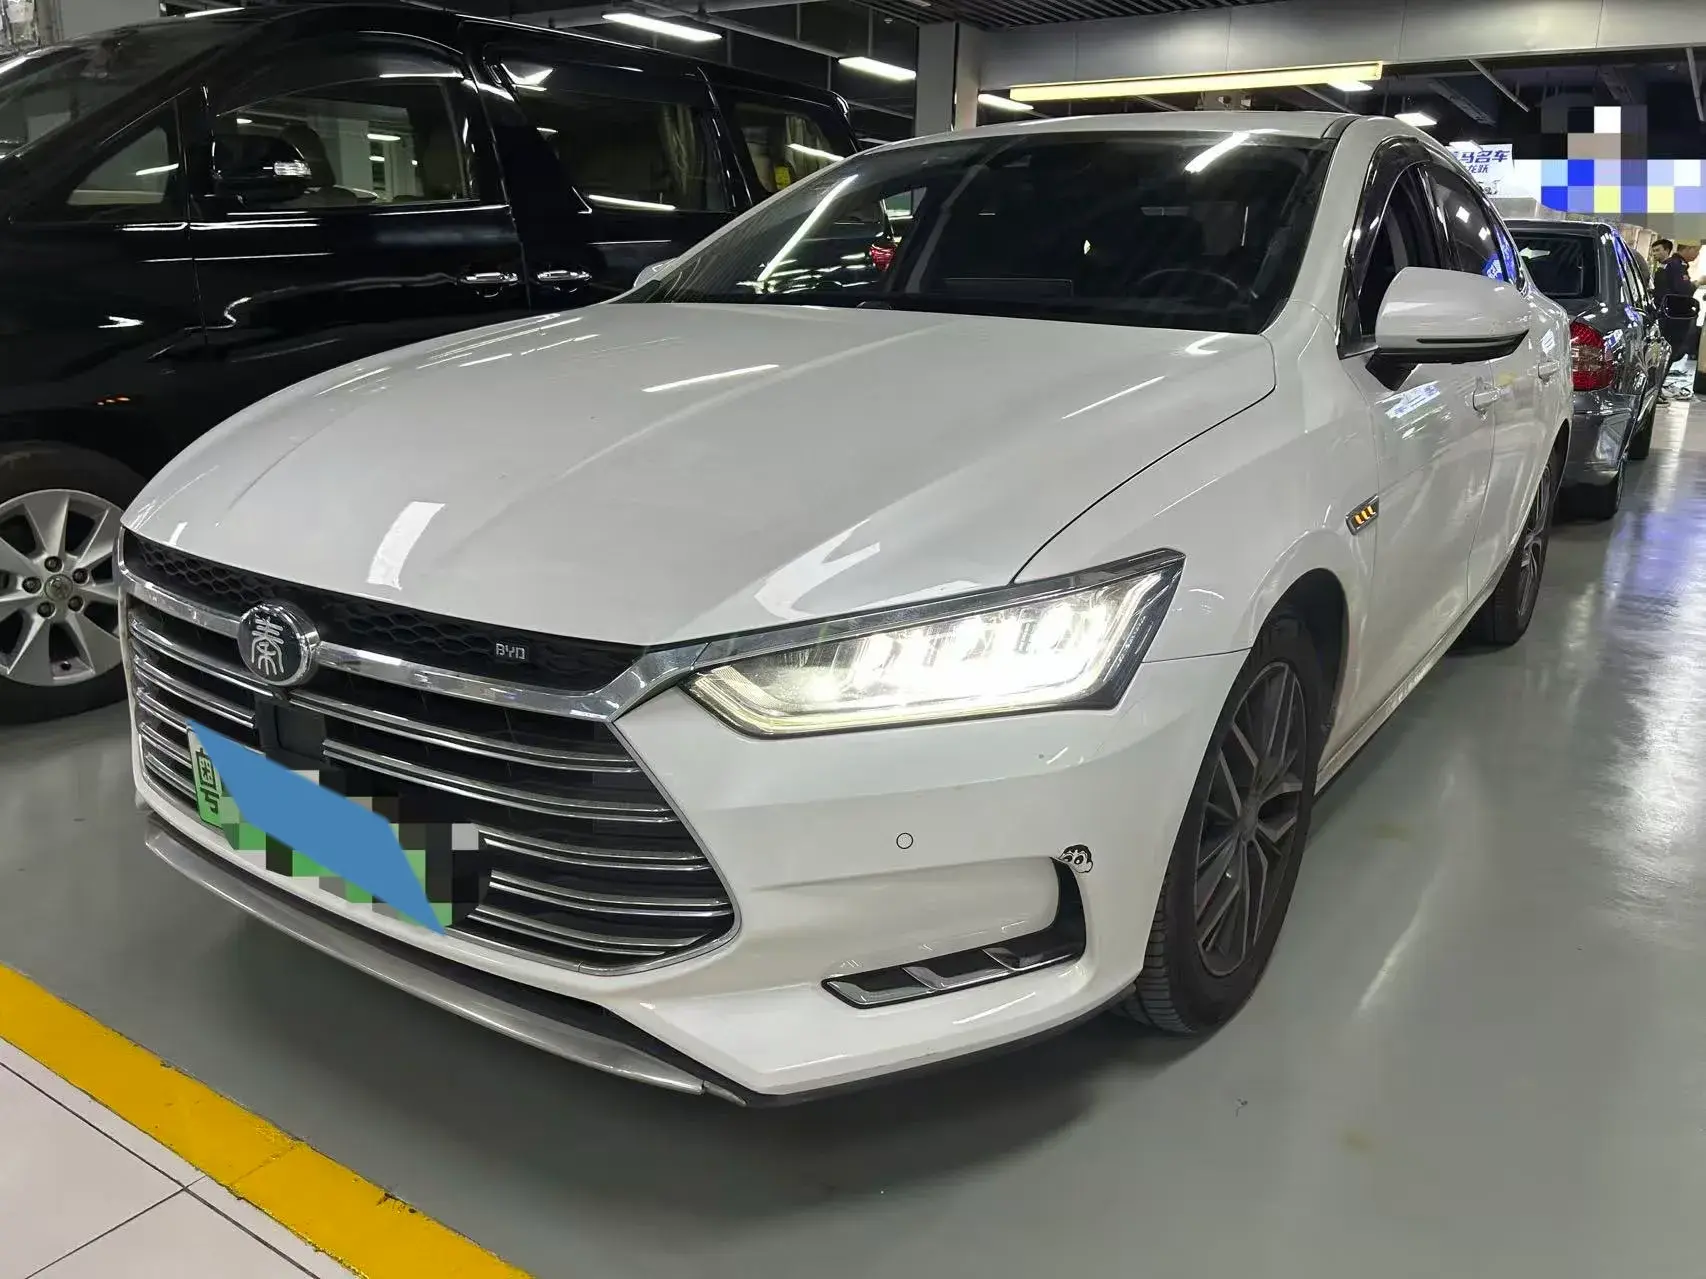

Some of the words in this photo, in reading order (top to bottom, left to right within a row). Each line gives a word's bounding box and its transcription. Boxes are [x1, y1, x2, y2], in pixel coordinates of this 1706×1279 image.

[1453, 149, 1510, 164] 马名车
[495, 643, 526, 660] BYD
[195, 747, 221, 815] 粤
